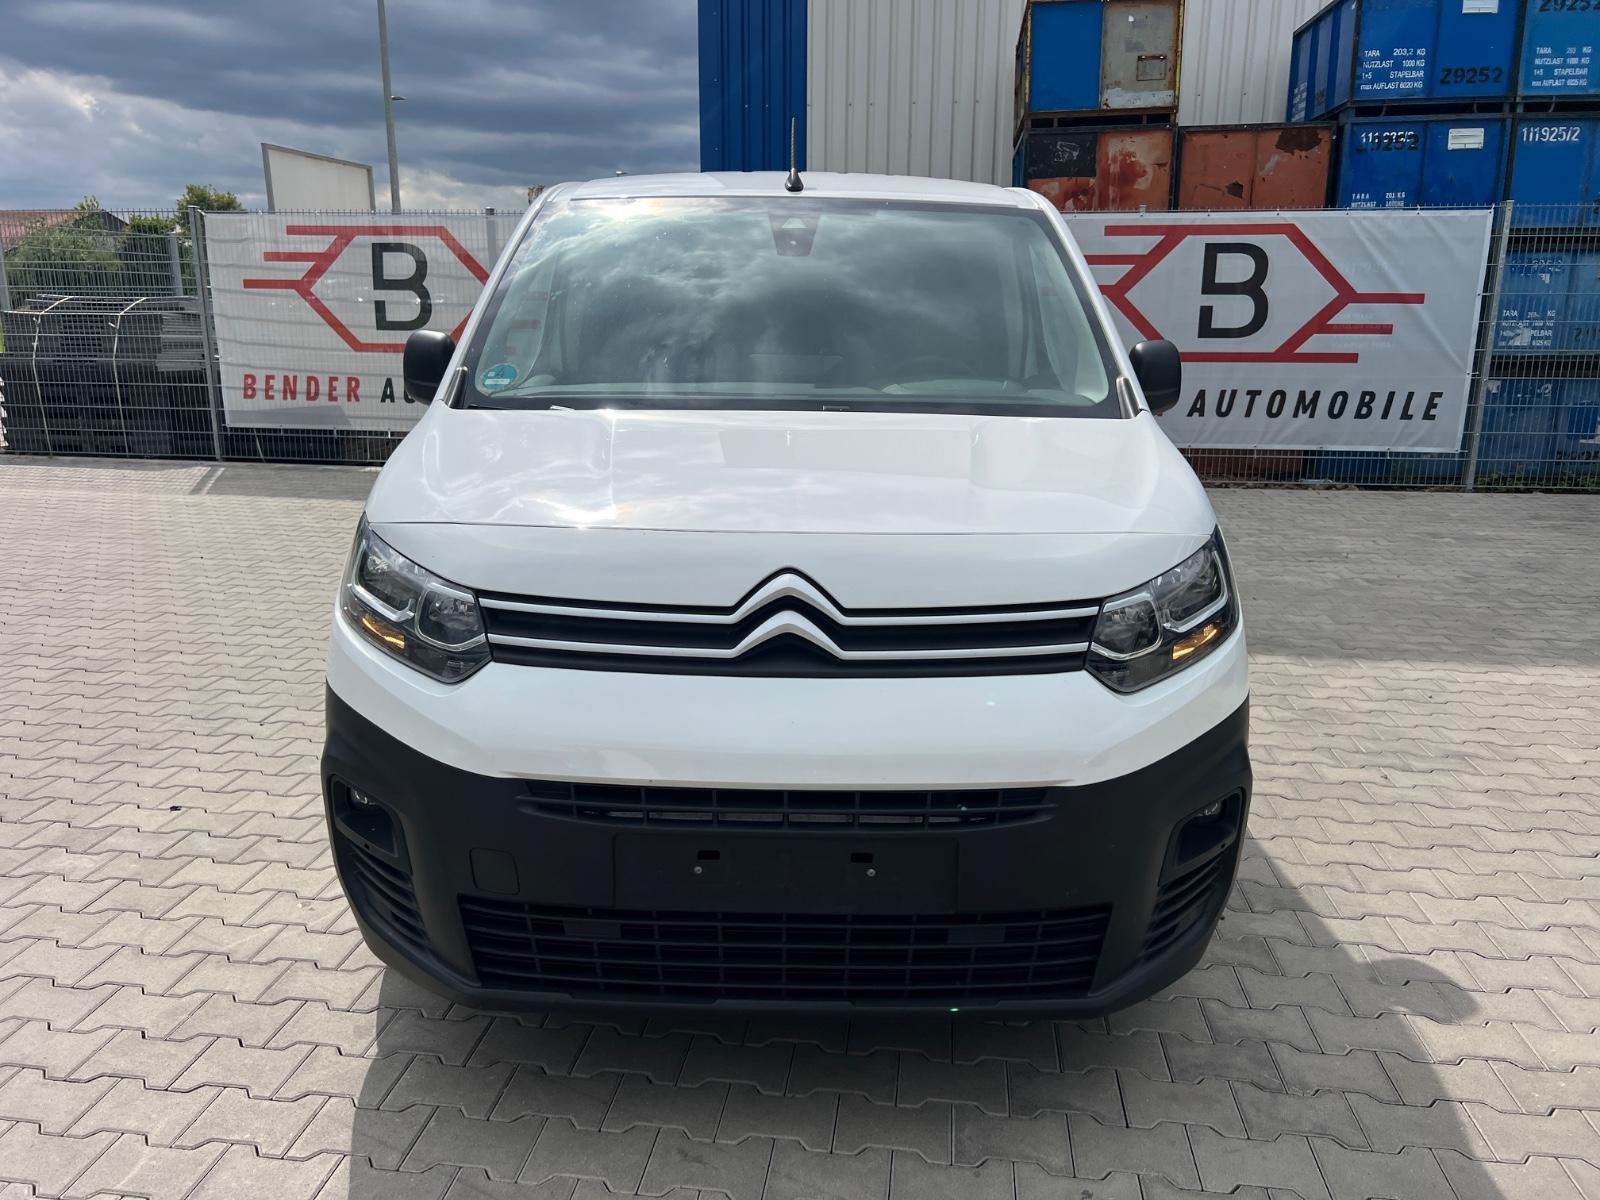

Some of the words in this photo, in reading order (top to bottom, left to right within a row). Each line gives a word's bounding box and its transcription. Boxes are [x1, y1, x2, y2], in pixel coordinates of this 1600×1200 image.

[1417, 48, 1426, 56] KG
[1363, 60, 1394, 68] NUTZLAST
[1440, 66, 1504, 84] Z9252
[1522, 126, 1581, 142] 111925/2
[372, 242, 432, 331] B
[1197, 242, 1269, 339] B
[243, 374, 360, 402] BENDER
[1187, 389, 1444, 421] AUTOMOBILE
